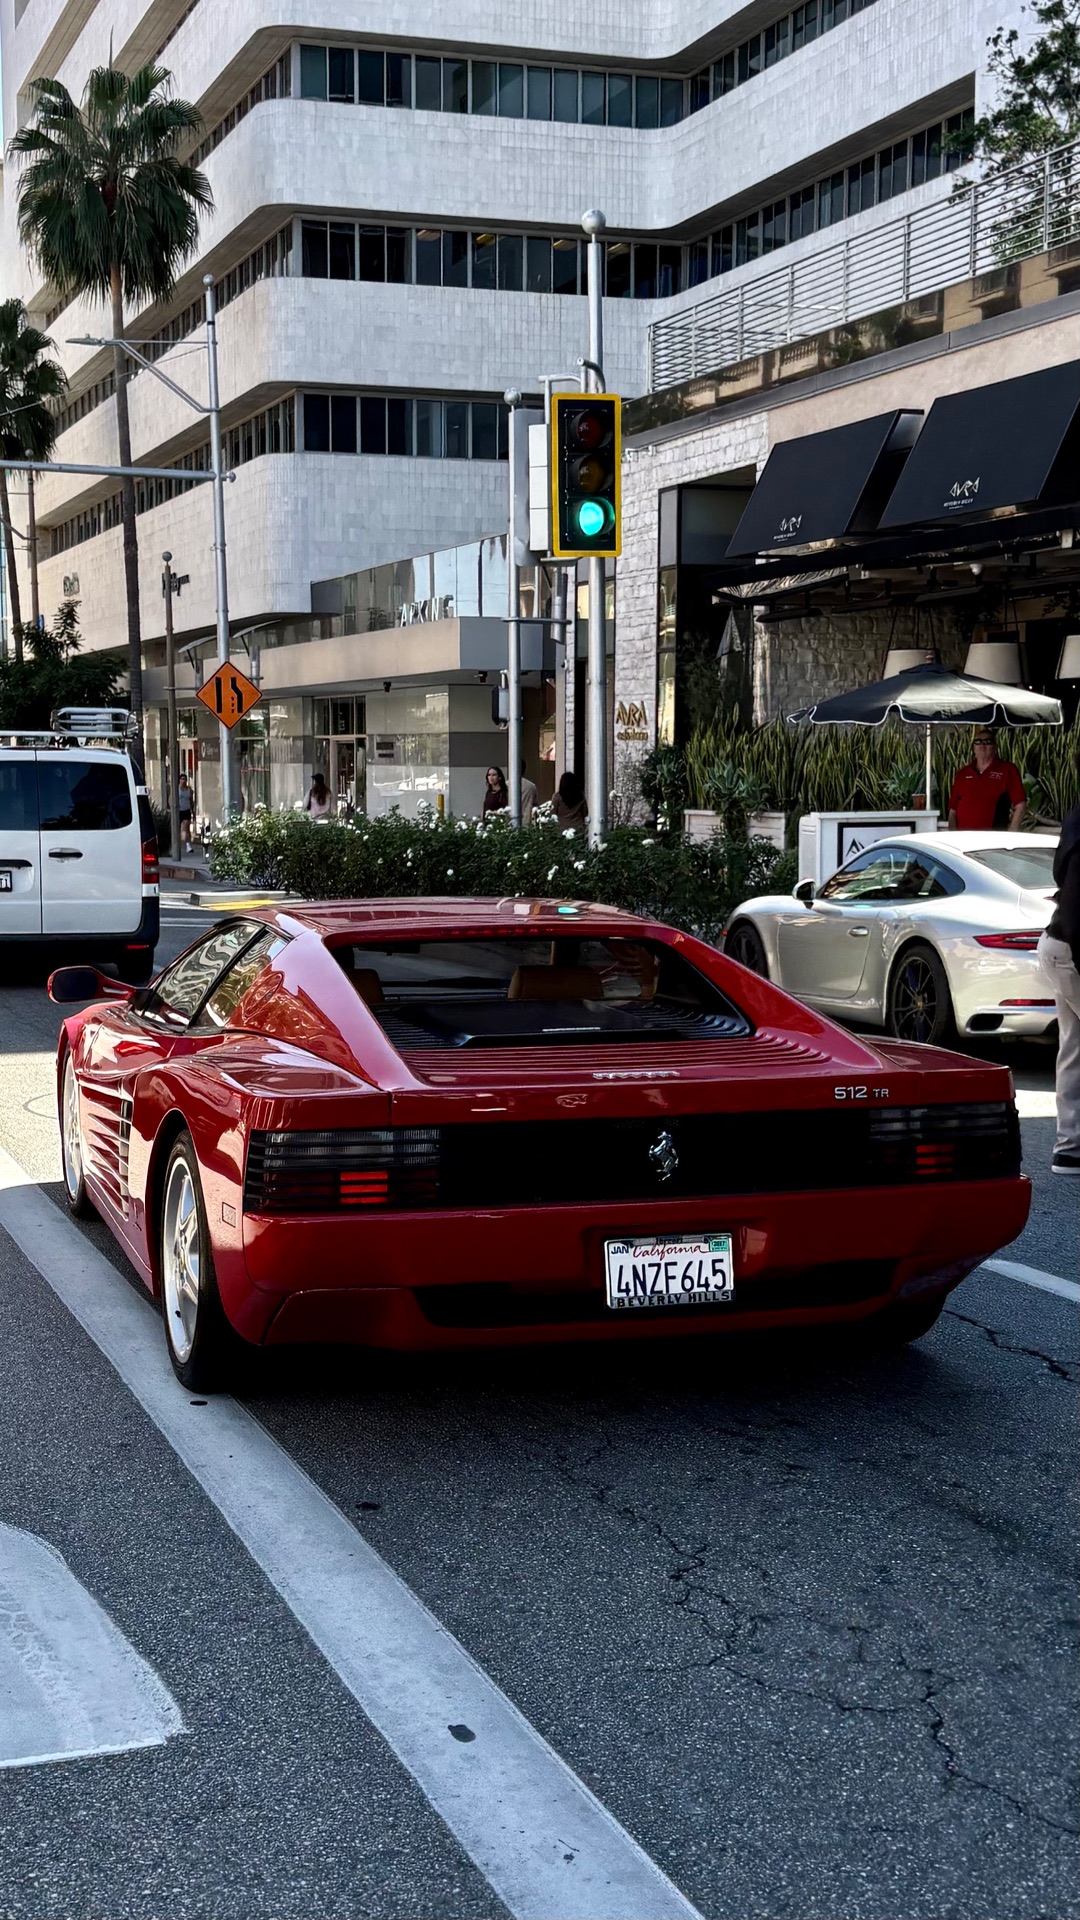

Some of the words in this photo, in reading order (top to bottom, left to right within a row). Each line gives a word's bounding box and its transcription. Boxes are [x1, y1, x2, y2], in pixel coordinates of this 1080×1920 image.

[834, 1085, 868, 1099] 512
[872, 1088, 890, 1098] TR
[611, 1245, 629, 1255] JAN
[632, 1245, 710, 1261] California
[617, 1258, 727, 1297] 4NZF645
[617, 1294, 683, 1308] BEVERLY
[688, 1291, 731, 1304] HILLS
